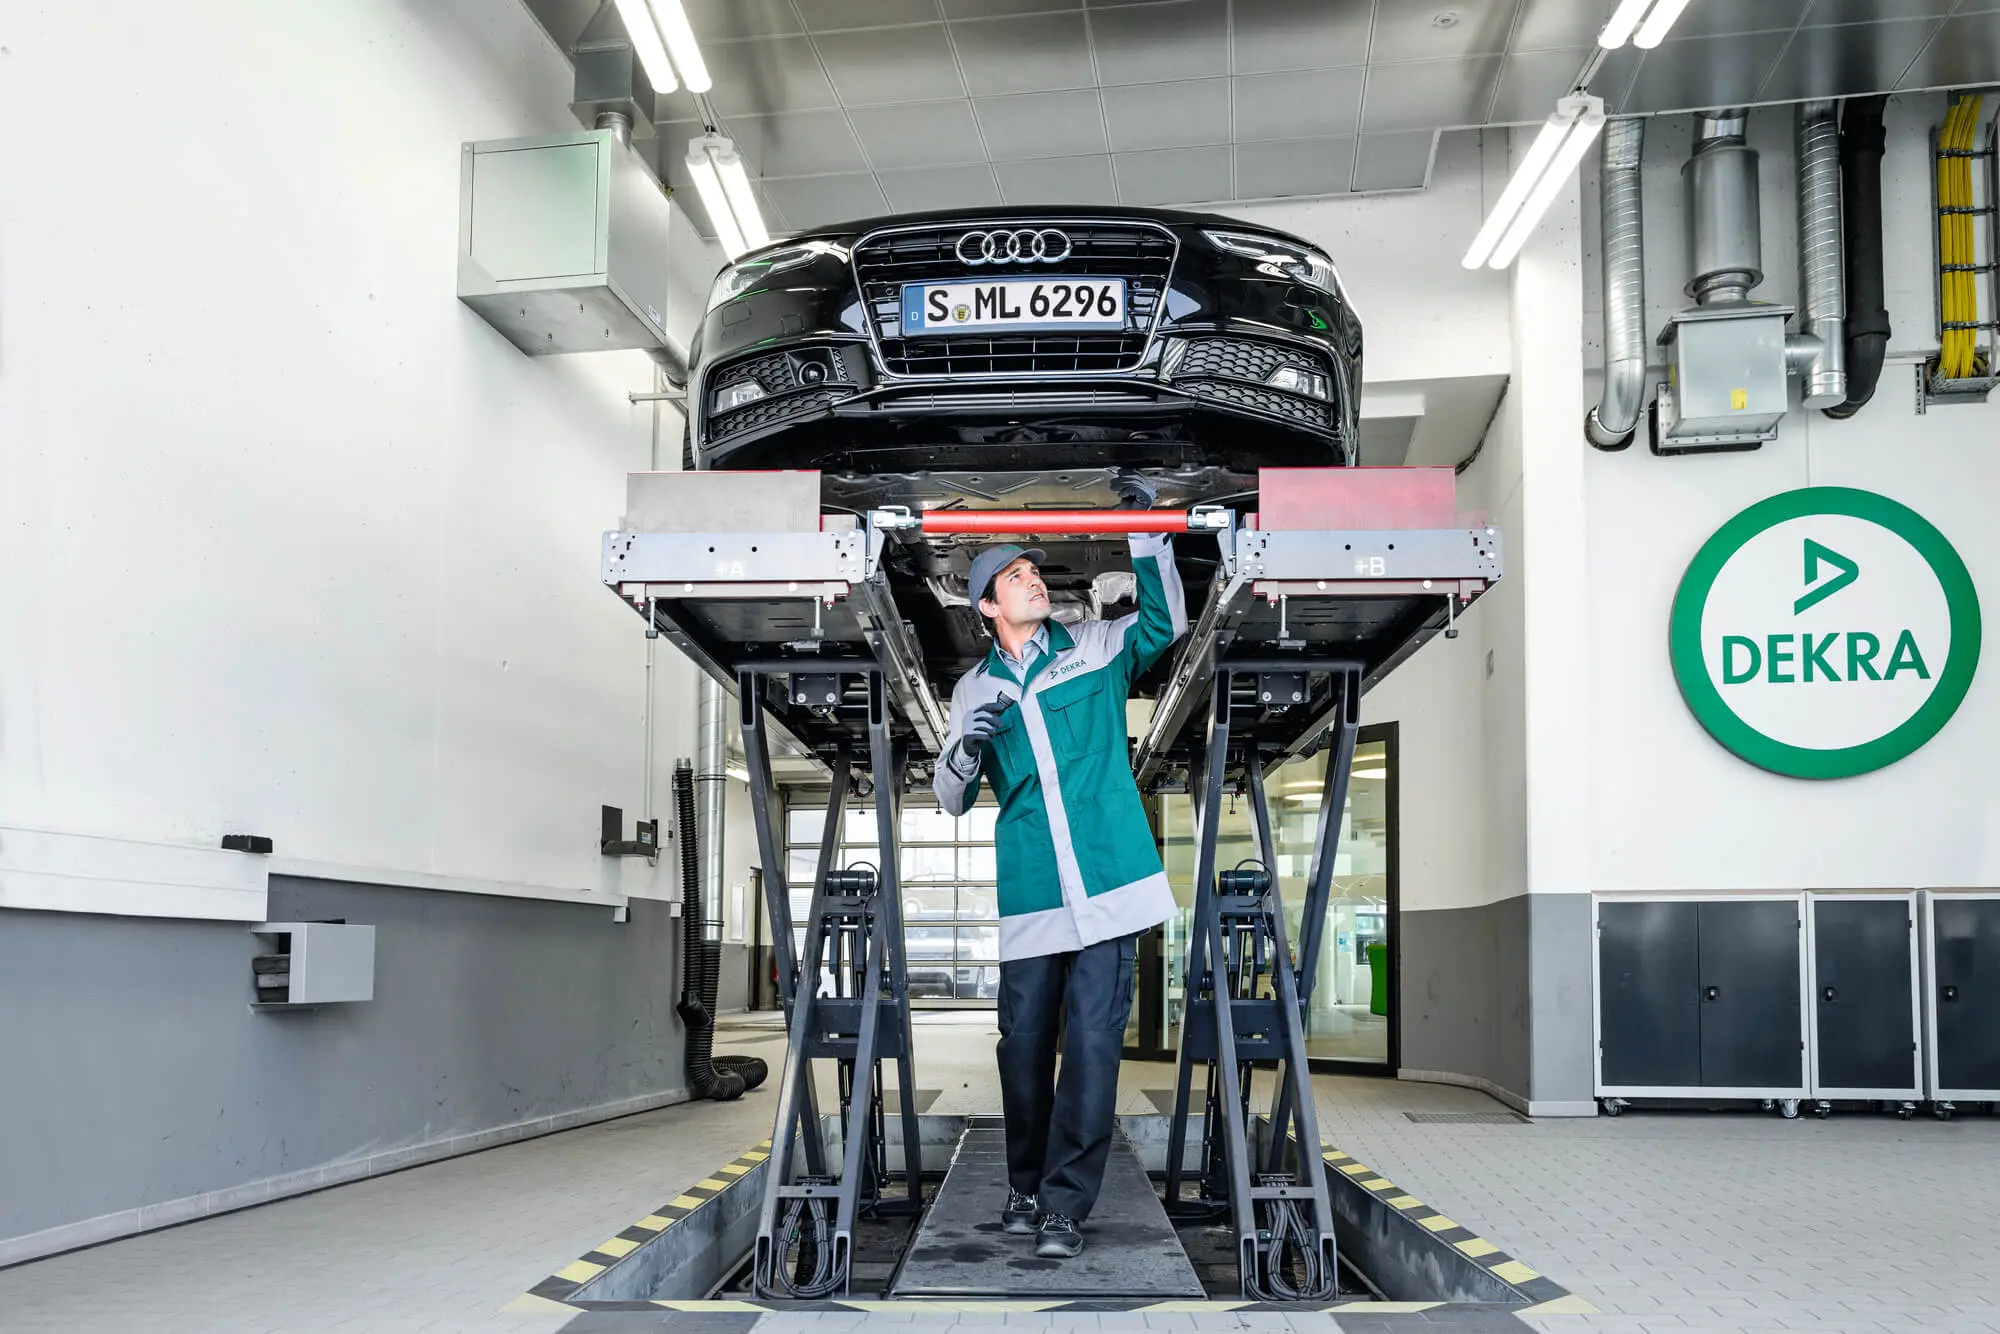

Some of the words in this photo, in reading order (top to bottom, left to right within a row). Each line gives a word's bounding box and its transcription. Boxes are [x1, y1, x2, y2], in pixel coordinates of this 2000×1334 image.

[911, 311, 919, 321] D
[927, 289, 949, 322] S
[975, 286, 1021, 320] ML
[1029, 285, 1117, 318] 6296
[1060, 659, 1087, 674] DEKRA
[1722, 629, 1931, 685] DEKRA
